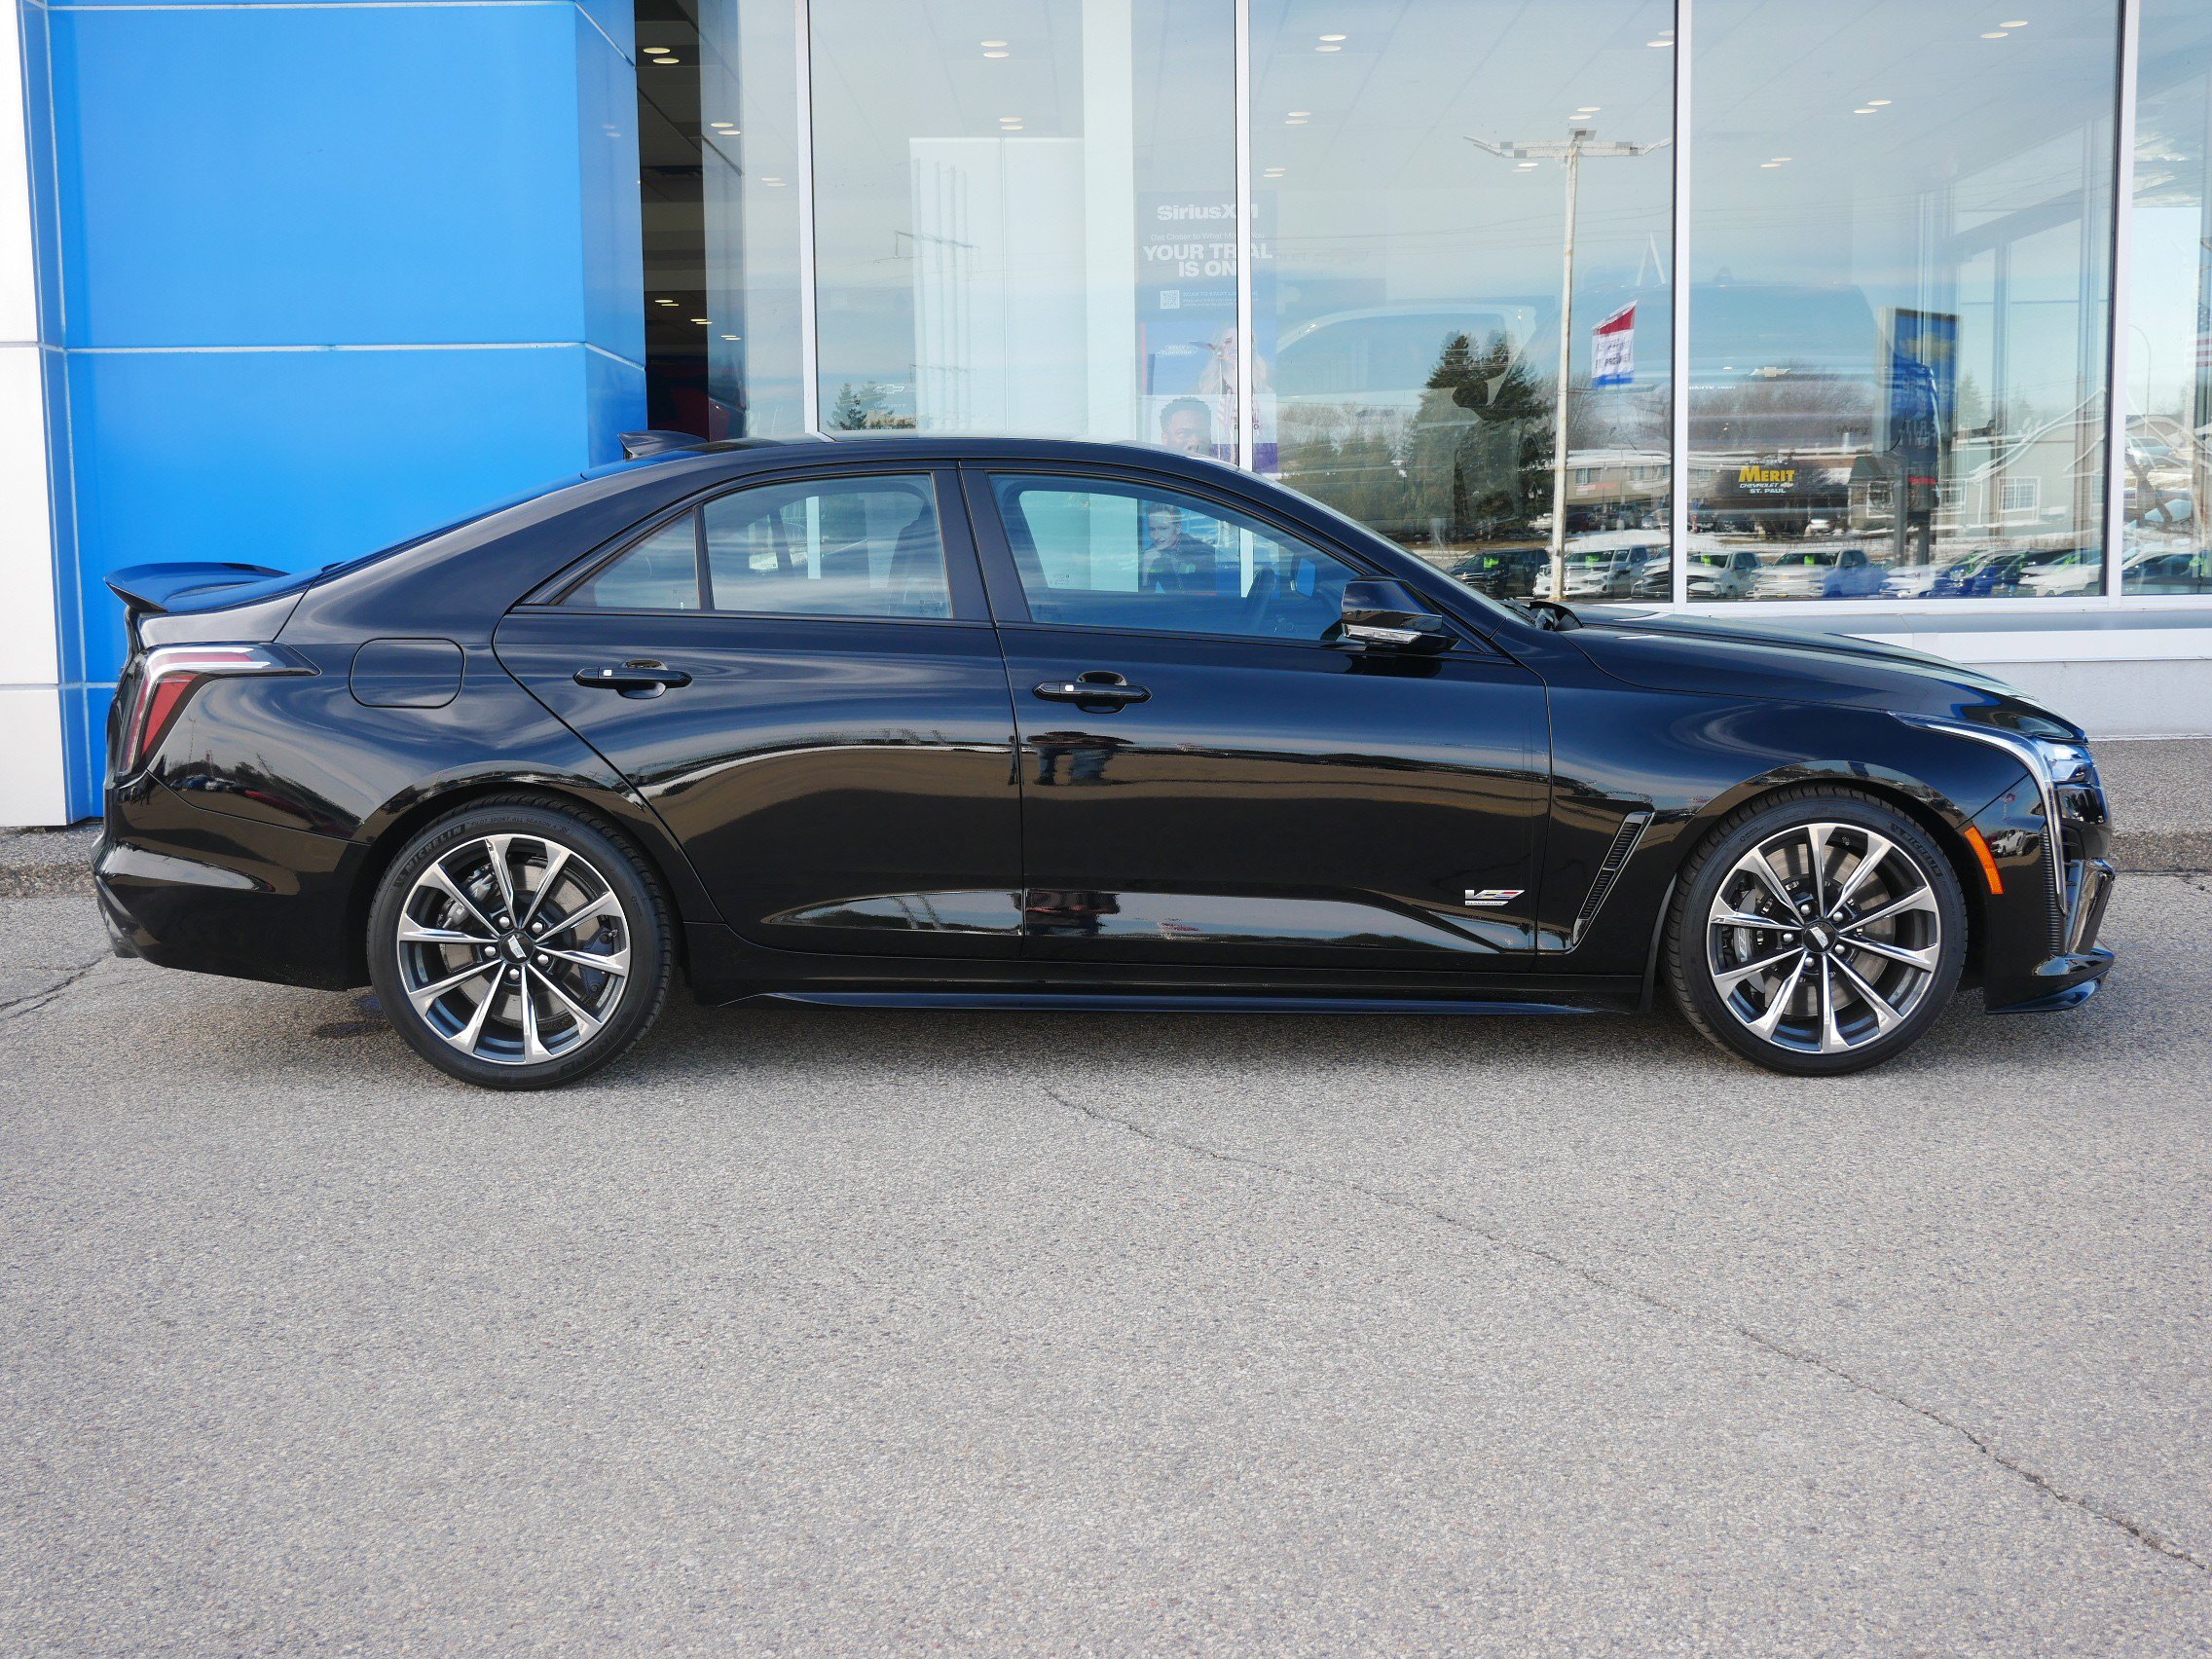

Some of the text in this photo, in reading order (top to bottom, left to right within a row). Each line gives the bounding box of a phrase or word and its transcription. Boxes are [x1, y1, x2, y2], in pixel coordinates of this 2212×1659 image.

[1143, 243, 1204, 261] YOUR
[1209, 242, 1273, 259] TRAL
[1178, 260, 1236, 277] IS ON
[1738, 464, 1795, 483] MERIT
[527, 817, 552, 828] SEASON
[405, 824, 466, 875] MICHELIN
